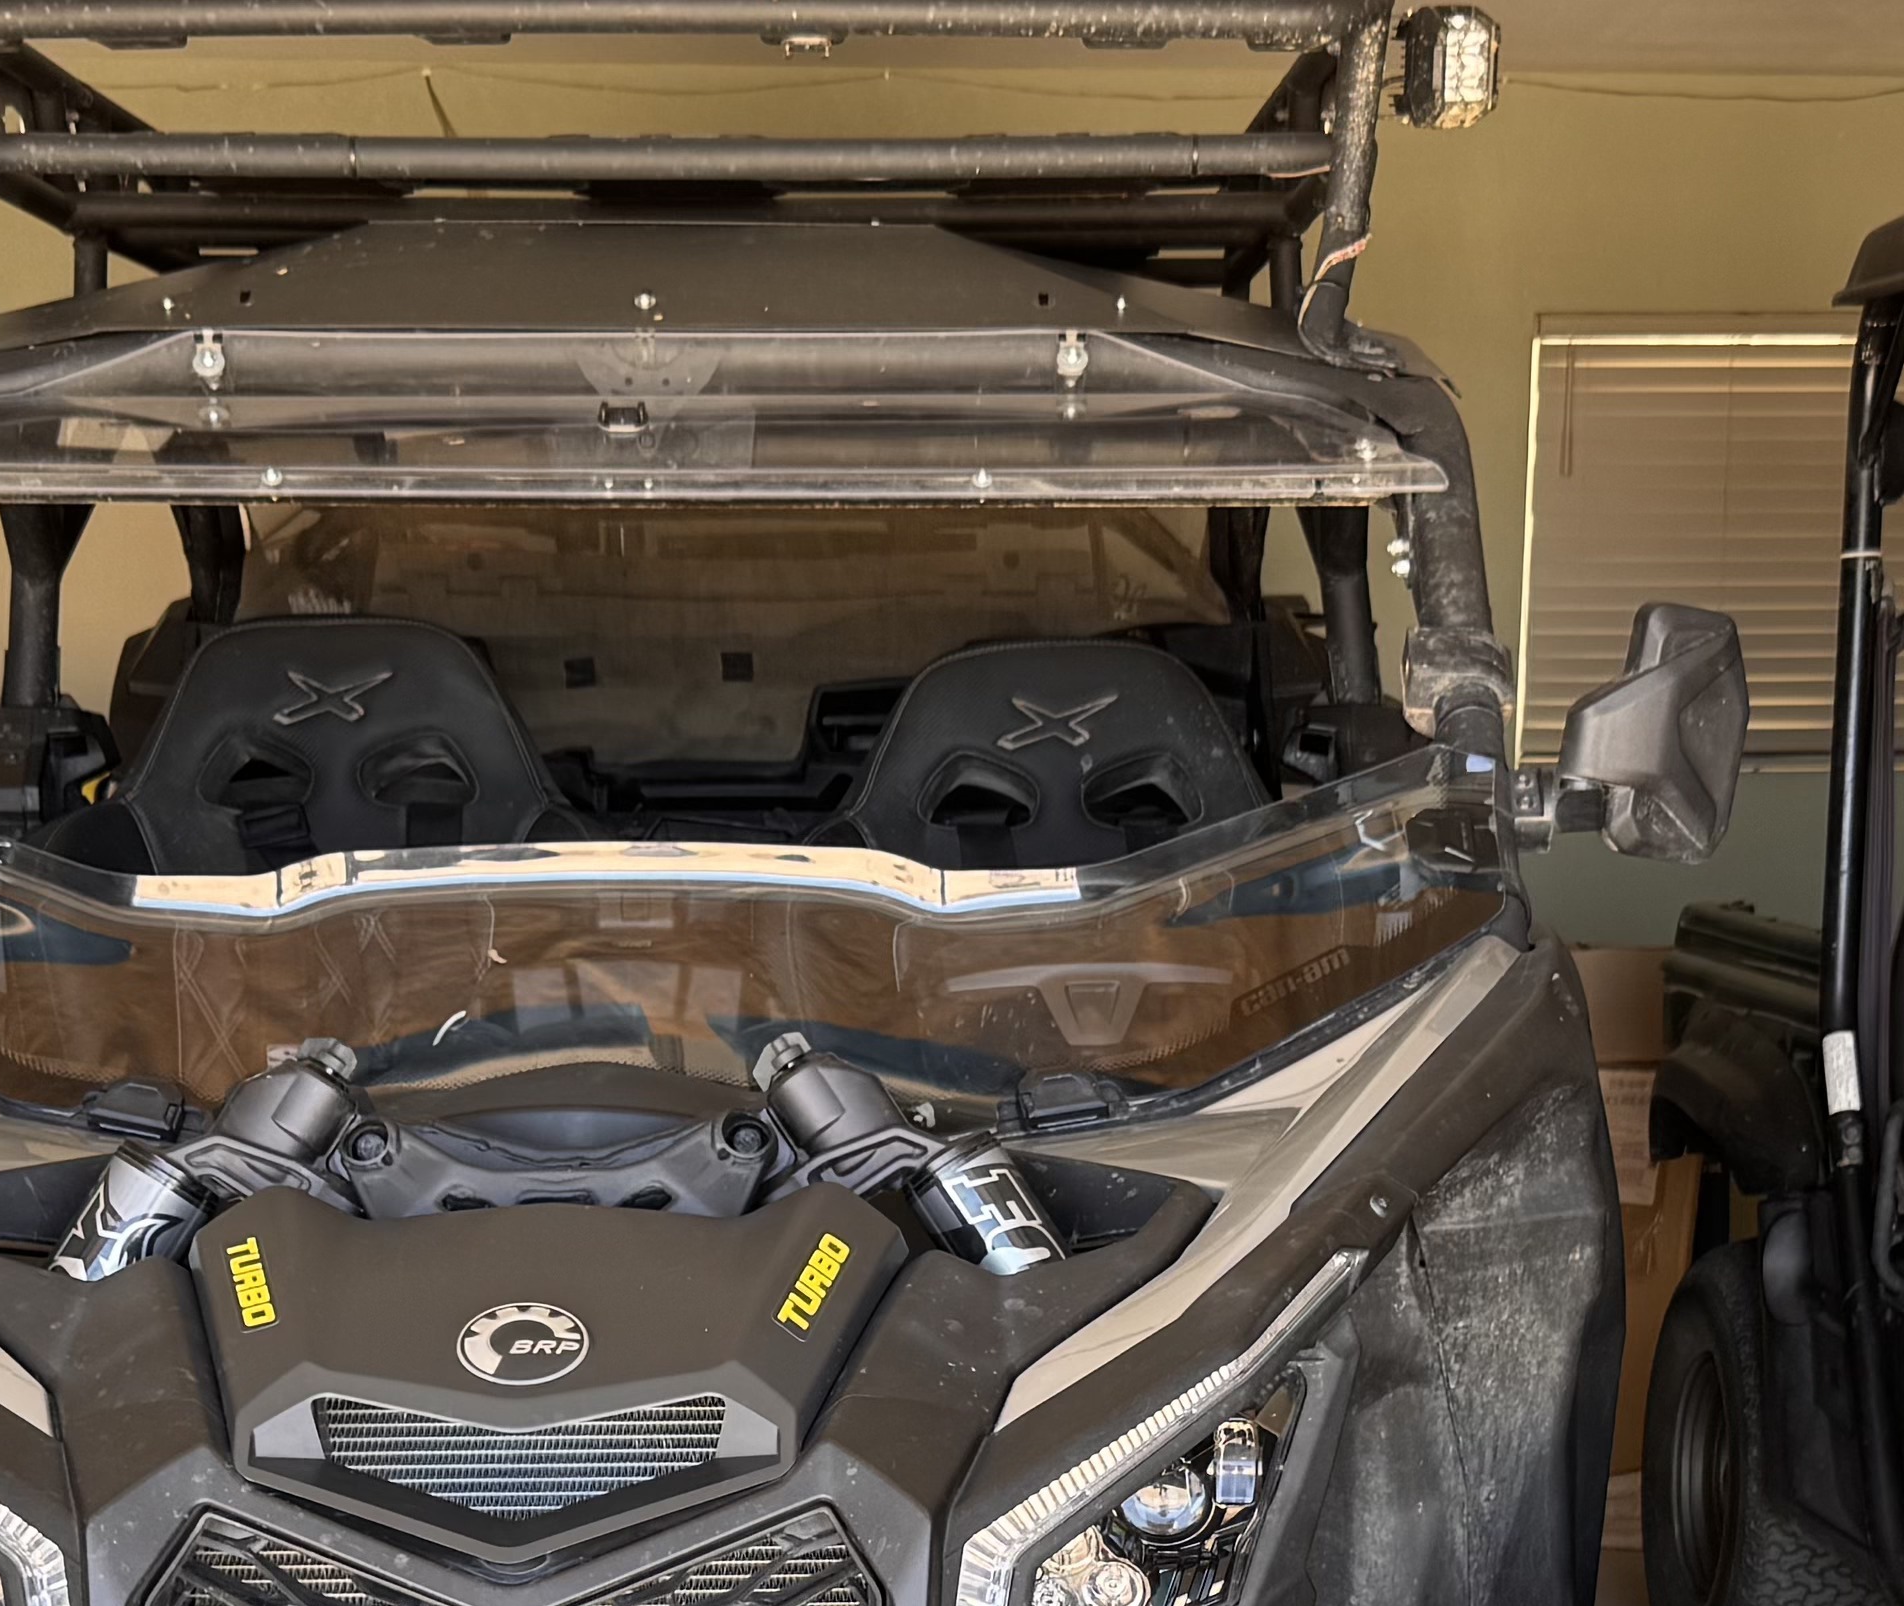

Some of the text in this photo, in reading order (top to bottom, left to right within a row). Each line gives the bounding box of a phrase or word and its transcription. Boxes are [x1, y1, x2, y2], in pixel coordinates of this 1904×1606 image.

[1240, 947, 1350, 1016] can-am
[226, 1236, 276, 1327] TURBO
[777, 1232, 850, 1331] TURBO
[508, 1339, 581, 1355] BRP
